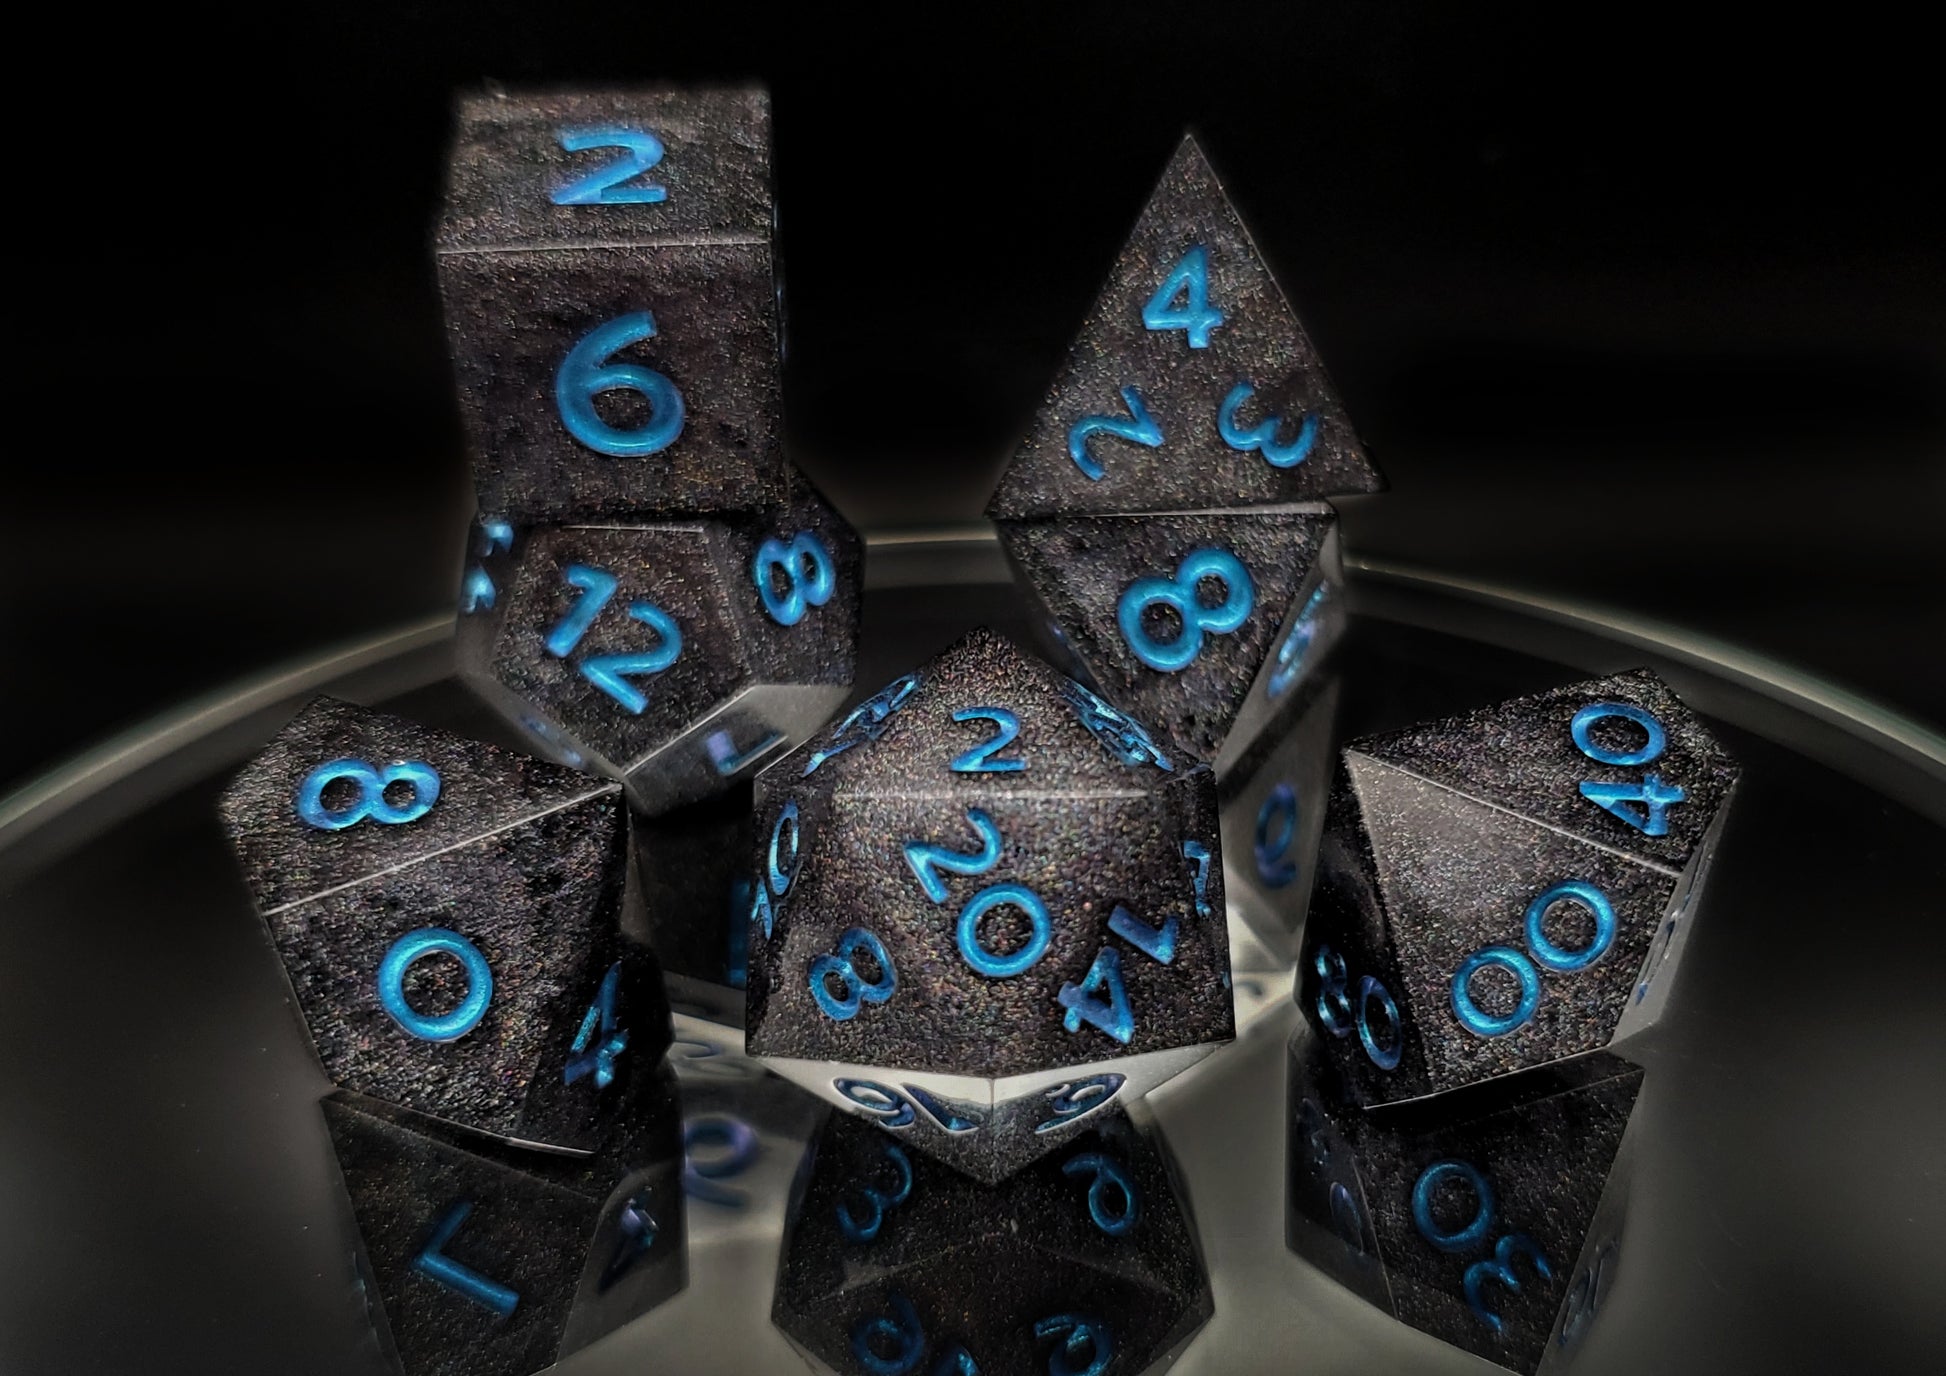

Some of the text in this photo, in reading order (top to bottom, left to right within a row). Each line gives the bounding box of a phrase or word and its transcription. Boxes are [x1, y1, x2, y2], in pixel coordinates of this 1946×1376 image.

[548, 125, 668, 207] 2
[1140, 245, 1225, 350] 4
[553, 310, 686, 458] 6
[1065, 384, 1164, 482] 2
[1217, 381, 1320, 470] 3
[750, 529, 837, 628] 8
[1117, 546, 1256, 674] 8
[543, 563, 684, 717] 12
[296, 757, 443, 832] 8
[950, 705, 1026, 774] 2
[1570, 702, 1685, 838] 40
[903, 806, 1053, 978] 20
[376, 926, 495, 1043] 0
[808, 926, 898, 1022] 8
[1056, 905, 1180, 1045] 14
[1450, 878, 1617, 1038] 00
